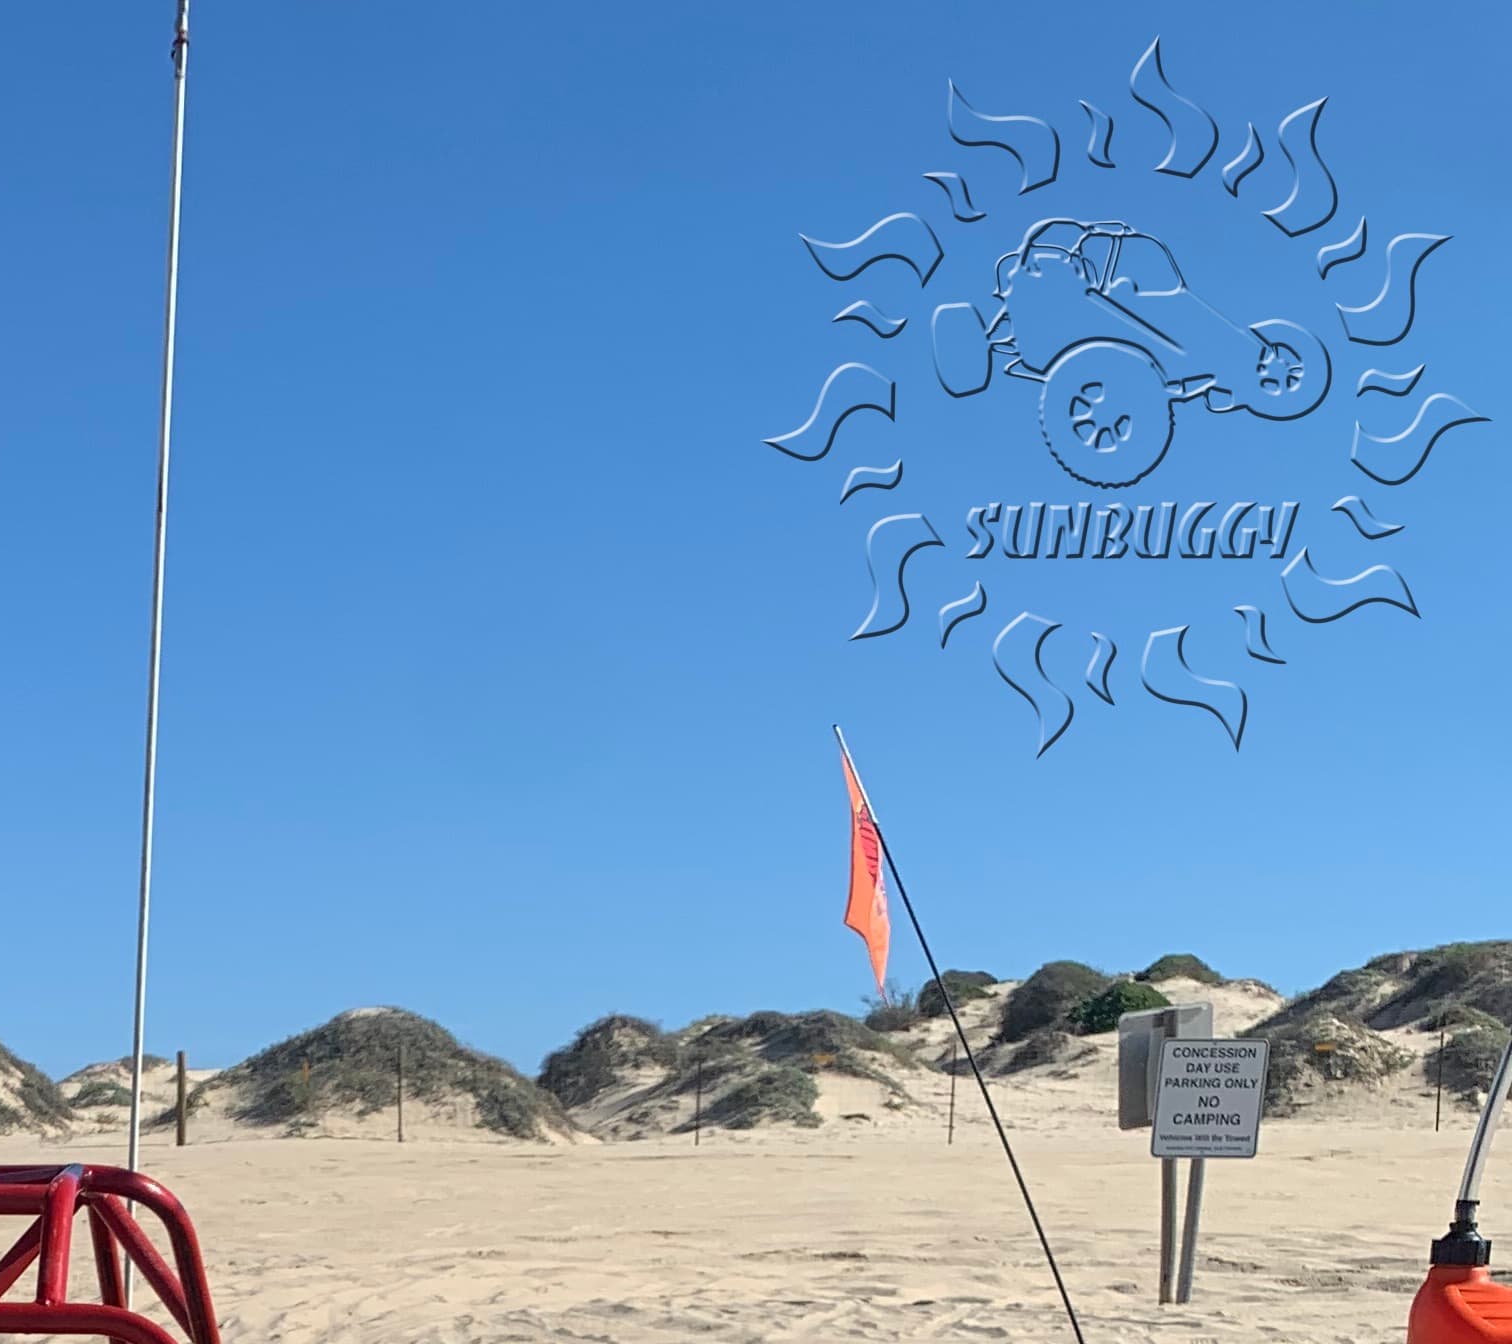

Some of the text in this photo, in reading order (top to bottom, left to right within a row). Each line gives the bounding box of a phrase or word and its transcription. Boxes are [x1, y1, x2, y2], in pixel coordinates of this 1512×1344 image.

[1172, 1047, 1257, 1058] CONCESSION
[1186, 1062, 1241, 1073] DAY USE
[1164, 1078, 1258, 1089] PARKING ONLY
[1197, 1095, 1220, 1108] NO
[1172, 1113, 1241, 1125] CAMPING
